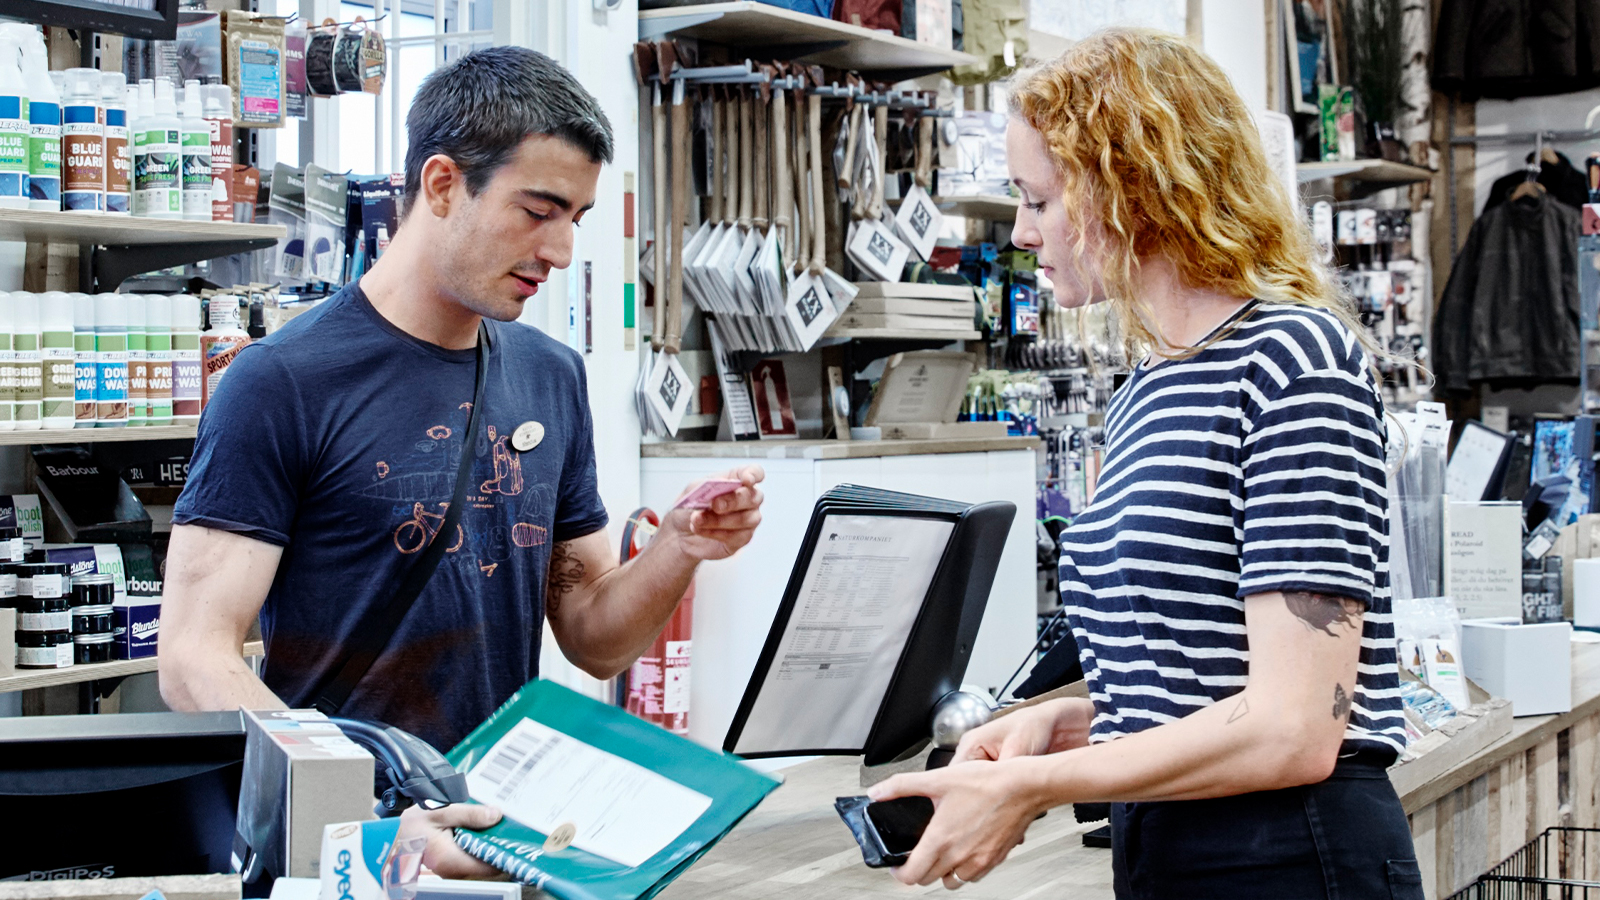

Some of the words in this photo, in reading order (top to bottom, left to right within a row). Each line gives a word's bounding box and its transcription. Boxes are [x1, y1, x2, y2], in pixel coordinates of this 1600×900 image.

[72, 143, 102, 155] BLUE
[46, 465, 99, 477] Barbour
[16, 505, 41, 521] boot
